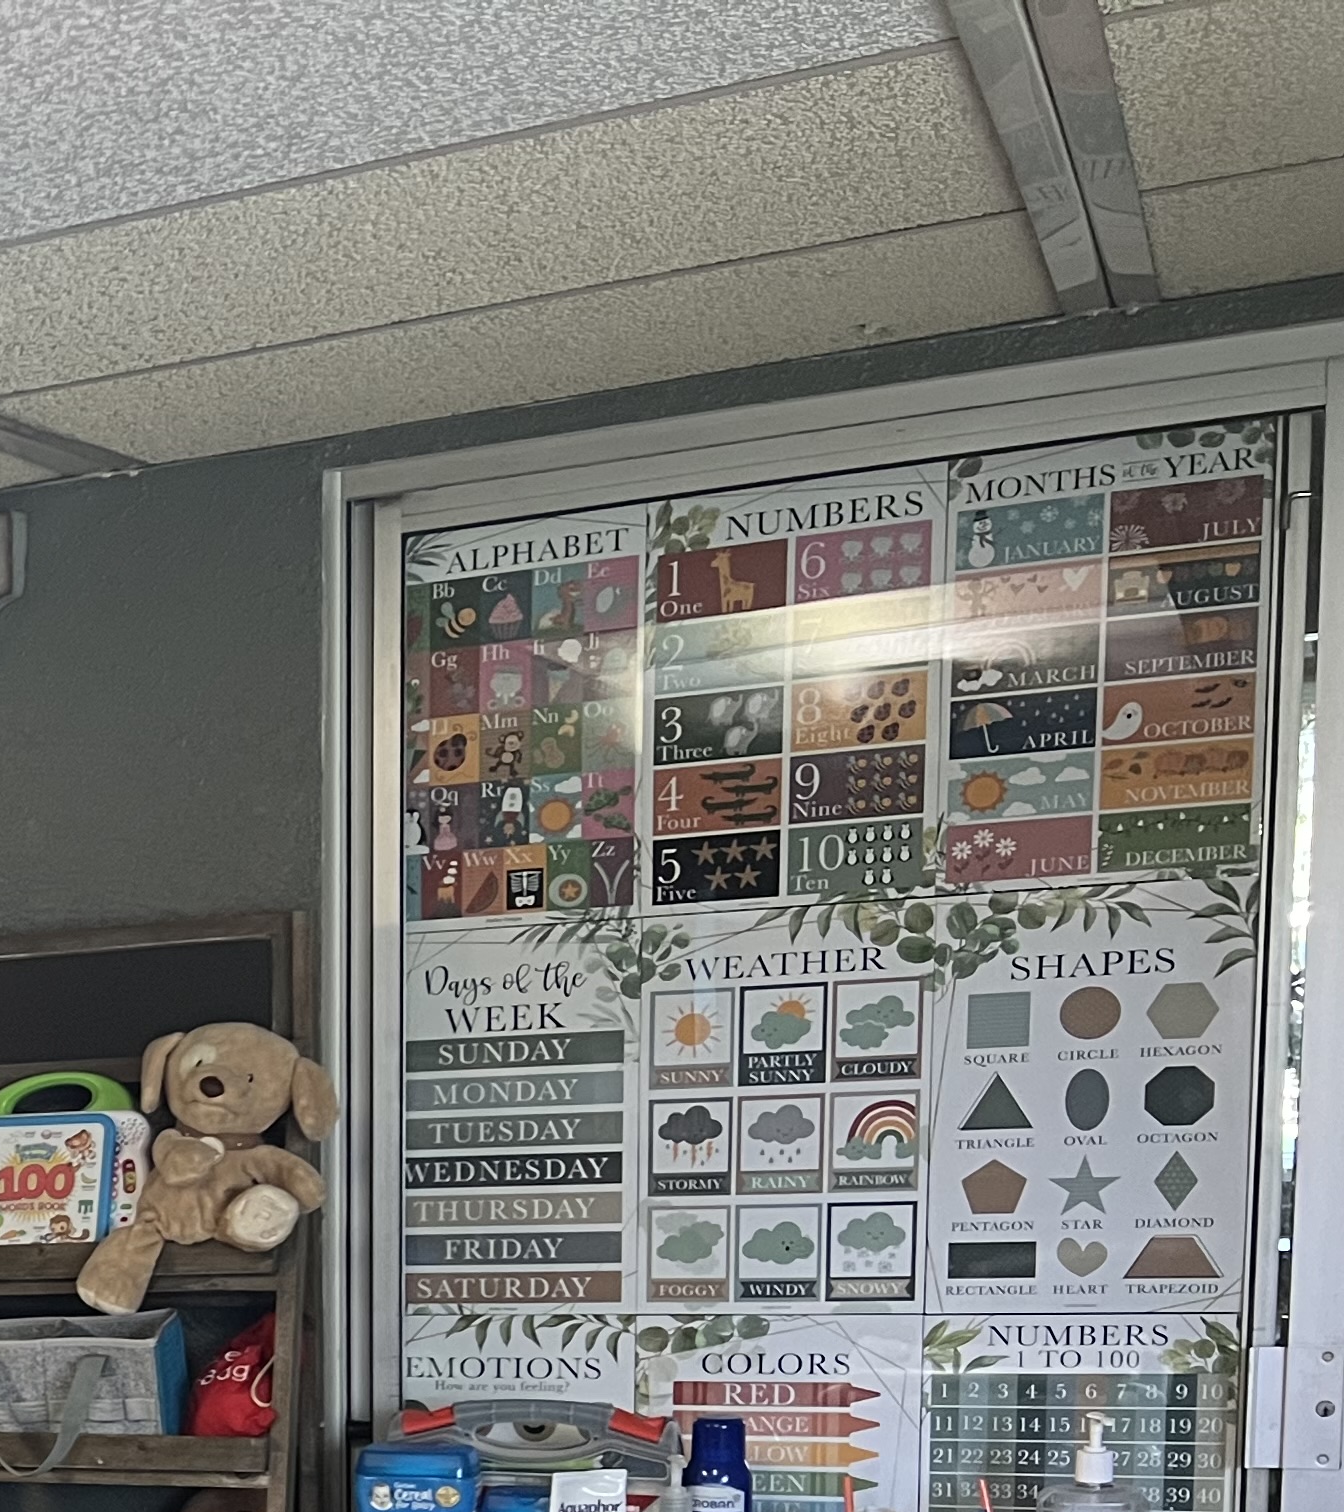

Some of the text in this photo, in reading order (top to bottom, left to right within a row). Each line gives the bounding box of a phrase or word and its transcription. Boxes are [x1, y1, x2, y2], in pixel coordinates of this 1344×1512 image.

[965, 447, 1255, 504] MONTHS YEAR
[725, 490, 924, 541] NUMBERS
[1200, 517, 1260, 542] JULY
[446, 528, 629, 575] ALPHABET
[1003, 536, 1101, 563] JANUARY
[801, 542, 825, 579] 6
[433, 568, 561, 599] Bb Cc Dd
[667, 561, 681, 596] 1
[798, 584, 830, 600] Six
[1161, 583, 1259, 608] AUGUST
[661, 601, 703, 617] One
[431, 644, 509, 670] Gg Hh
[663, 635, 684, 671] 2
[1125, 650, 1254, 675] SEPTEMBER
[660, 675, 701, 691] Two
[1007, 664, 1096, 687] MARCH
[797, 688, 821, 726] 8
[481, 708, 558, 730] Mm Nn
[661, 707, 682, 743] 3
[1143, 715, 1252, 738] OCTOBER
[796, 726, 851, 745] Eight
[1022, 730, 1094, 750] APRIL
[657, 746, 712, 762] Three
[795, 763, 820, 800] 9
[1125, 779, 1250, 804] NOVEMBER
[431, 778, 549, 806] Qq Rr Ss
[657, 776, 684, 812] 4
[1040, 792, 1089, 810] MAY
[793, 801, 842, 819] Nine
[657, 814, 701, 831] Four
[423, 841, 615, 870] Vv Ww Yy Zz
[798, 834, 845, 873] 10
[1126, 844, 1247, 867] DECEMBER
[658, 849, 681, 884] 5
[1026, 855, 1090, 877] JUNE
[790, 875, 829, 891] Ten
[657, 886, 696, 902] Five
[685, 947, 887, 981] WEATHER
[1010, 947, 1175, 982] SHAPES
[425, 961, 587, 1006] Days of the
[445, 1002, 567, 1034] WEEK
[438, 1038, 572, 1065] SUNDAY
[748, 1053, 817, 1069] PARTLY
[964, 1052, 1030, 1067] SQUARE
[1057, 1048, 1119, 1061] CIRCLE
[1140, 1044, 1223, 1058] HEXAGON
[660, 1068, 724, 1084] SUNNY
[748, 1069, 814, 1084] SUNNY
[841, 1060, 912, 1076] CLOUDY
[433, 1078, 579, 1106] MONDAY
[428, 1118, 581, 1144] TUESDAY
[1063, 1135, 1108, 1146] OVAL
[1137, 1131, 1219, 1144] OCTAGON
[955, 1137, 1035, 1150] TRIANGLE
[405, 1157, 609, 1183] WEDNESDAY
[838, 1174, 908, 1186] RAINBOW
[657, 1178, 723, 1191] STORMY
[751, 1175, 811, 1189] RAINY
[413, 1197, 595, 1222] THURSDAY
[951, 1220, 1035, 1232] PENTAGON
[1061, 1219, 1104, 1230] STAR
[1134, 1217, 1215, 1229] DIAMOND
[444, 1238, 564, 1260] FRIDAY
[416, 1276, 592, 1299] SATURDAY
[659, 1283, 720, 1297] FOGGY
[749, 1283, 810, 1297] WINDY
[837, 1281, 906, 1296] SNOWY
[945, 1285, 1037, 1296] RECTANGLE
[1052, 1284, 1108, 1295] HEART
[1125, 1284, 1219, 1295] TRAPEZOID
[987, 1325, 1169, 1346] NUMBERS
[406, 1356, 602, 1380] EMOTIONS
[701, 1352, 850, 1376] COLORS
[1038, 1350, 1082, 1368] TO
[1097, 1350, 1140, 1368] 100
[435, 1380, 571, 1393] How are you feeling?
[724, 1383, 796, 1406] RED
[1201, 1384, 1223, 1400] 10
[745, 1416, 809, 1433] ANGE
[1020, 1416, 1223, 1434] 14 19 20
[1017, 1449, 1191, 1468] 24 29
[394, 1489, 432, 1501] Cereal
[1166, 1487, 1190, 1503] 39
